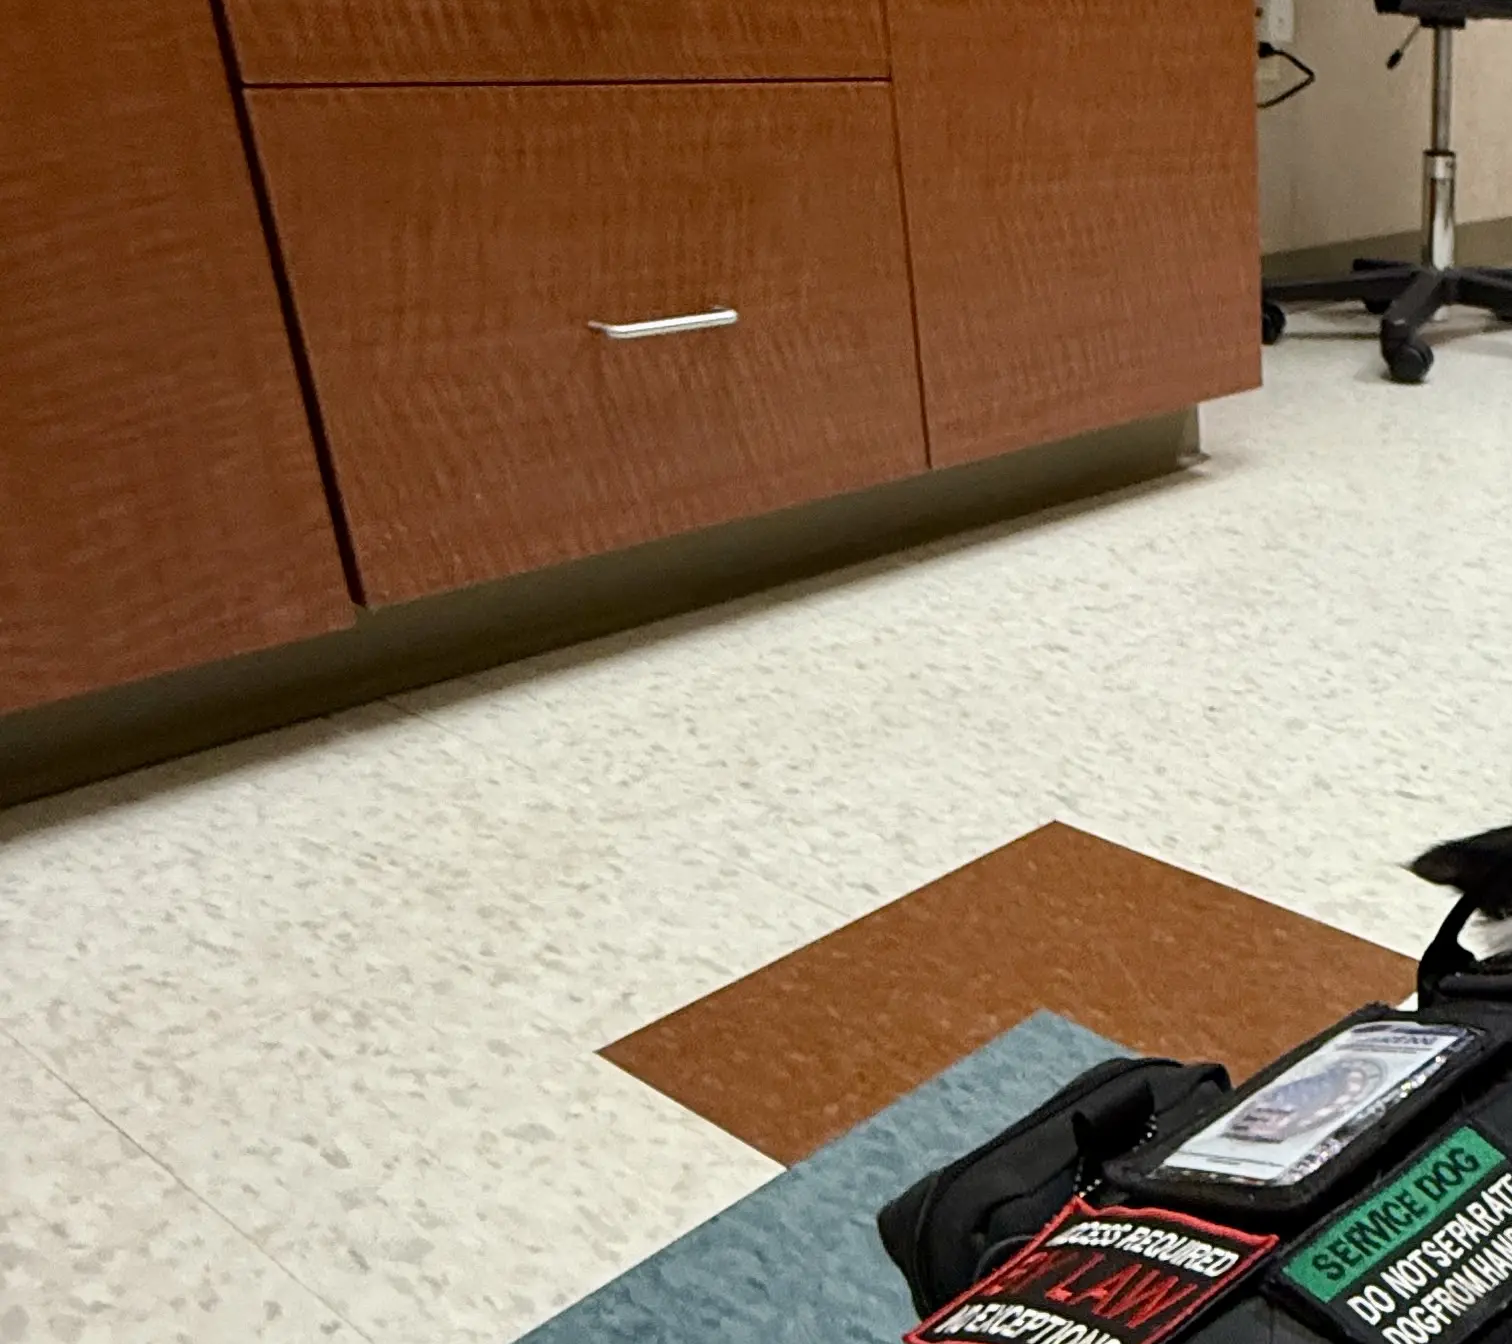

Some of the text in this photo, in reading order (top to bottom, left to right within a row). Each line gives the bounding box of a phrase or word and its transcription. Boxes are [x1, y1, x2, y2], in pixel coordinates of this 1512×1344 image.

[1114, 1222, 1240, 1279] REQUIRED
[1312, 1147, 1481, 1281] SERVICE DOG
[1044, 1253, 1198, 1330] LAW
[1346, 1284, 1396, 1326] DO
[1380, 1249, 1439, 1300] NOT
[1420, 1264, 1487, 1325] FROM
